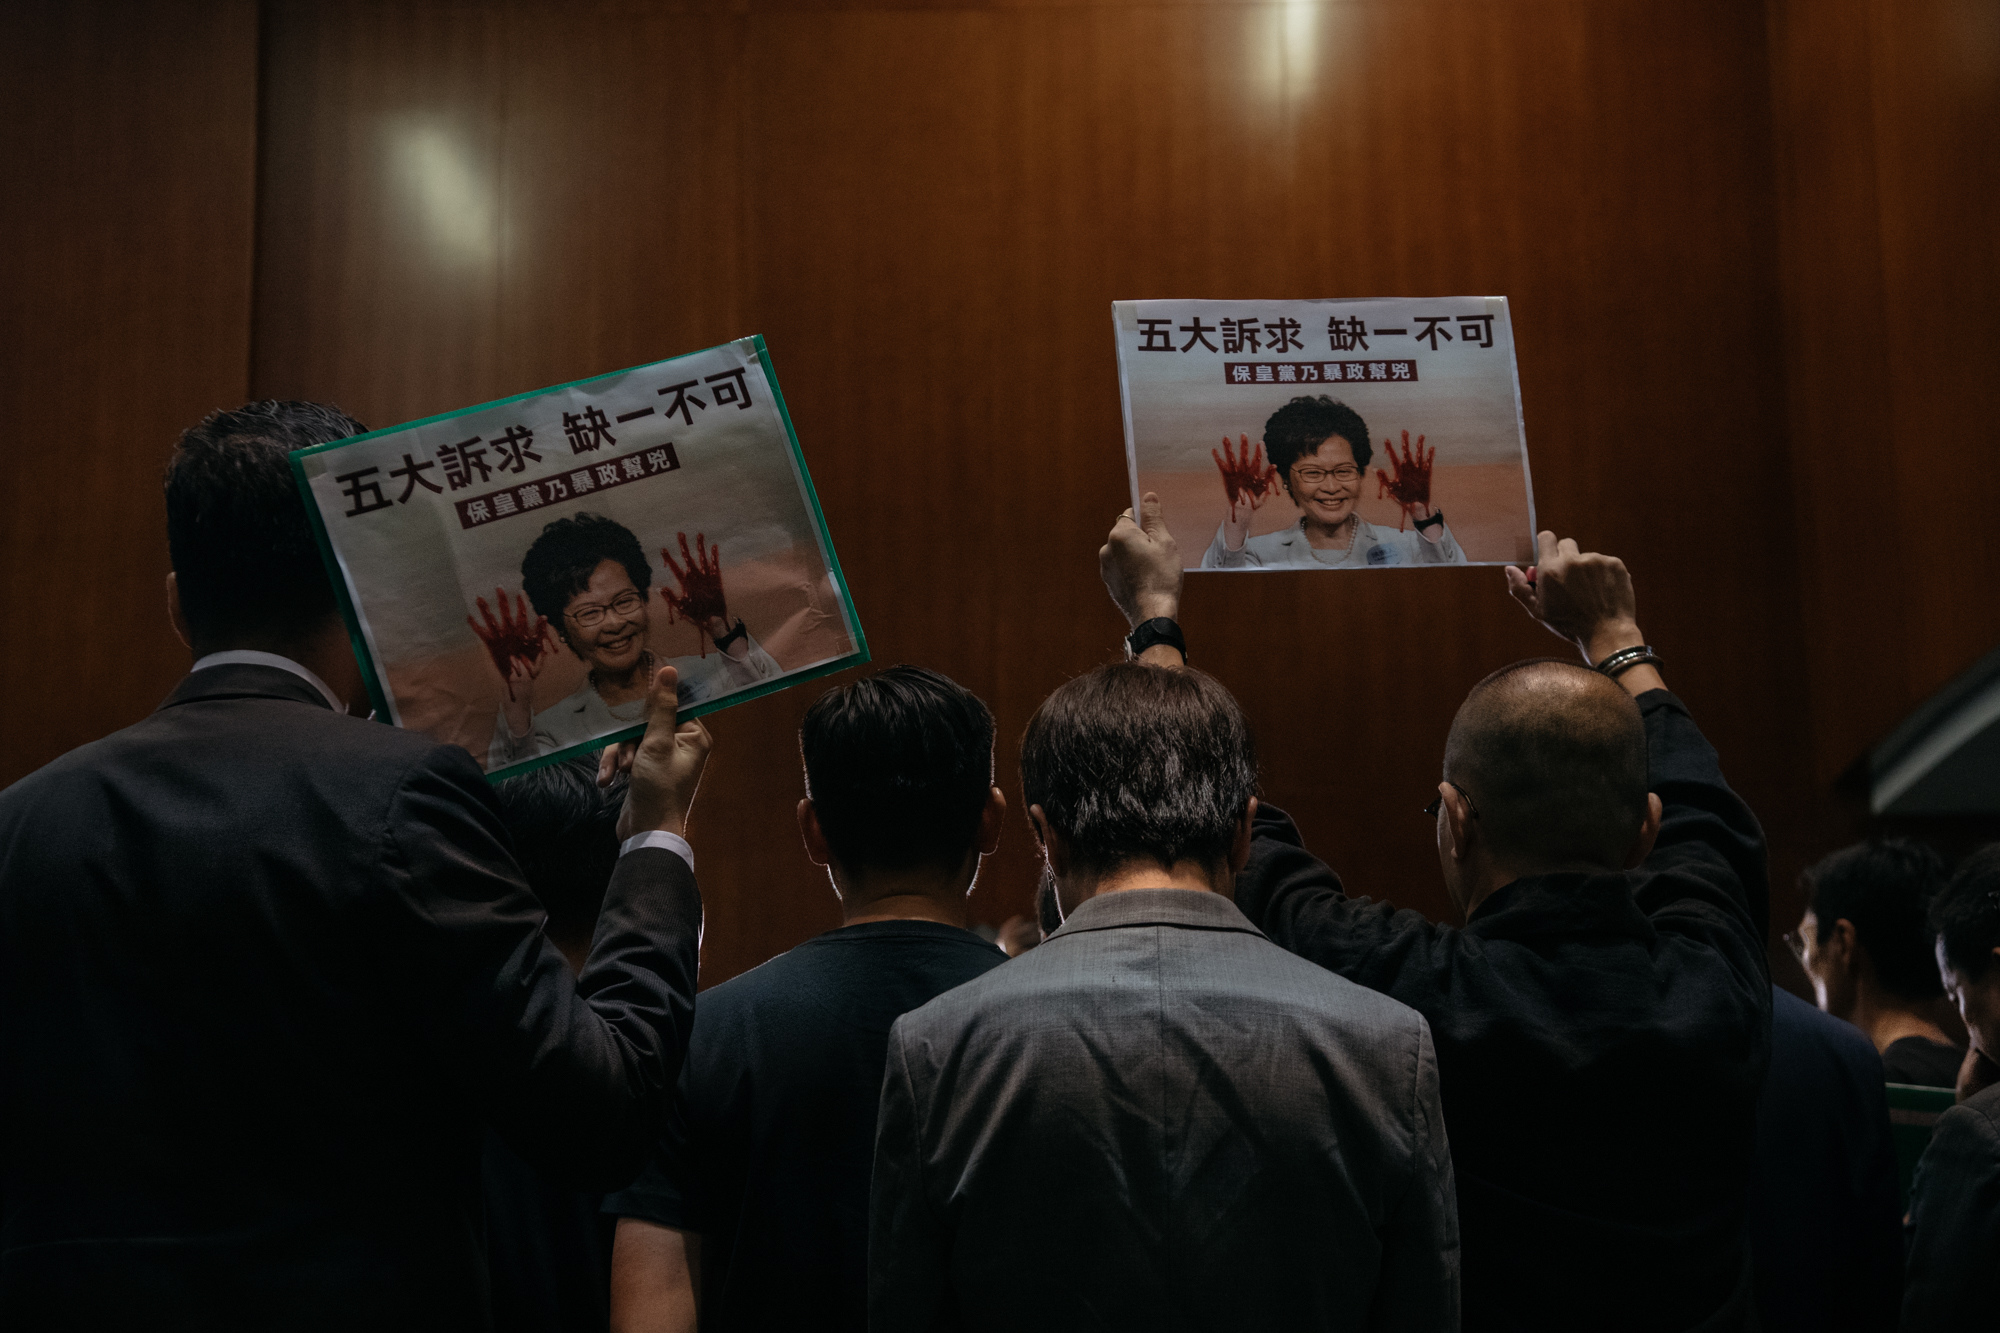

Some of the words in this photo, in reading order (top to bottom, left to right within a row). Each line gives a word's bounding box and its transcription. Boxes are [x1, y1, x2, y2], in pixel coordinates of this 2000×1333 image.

[1137, 317, 1304, 353] 五大訴求
[1328, 315, 1494, 351] 缺一不可
[1232, 362, 1411, 382] 保皇黨乃暴政幫兇
[335, 424, 542, 517] 五大訴求
[562, 367, 753, 455] 缺一不可
[466, 448, 671, 523] 保皇黨乃暴政幫兇
